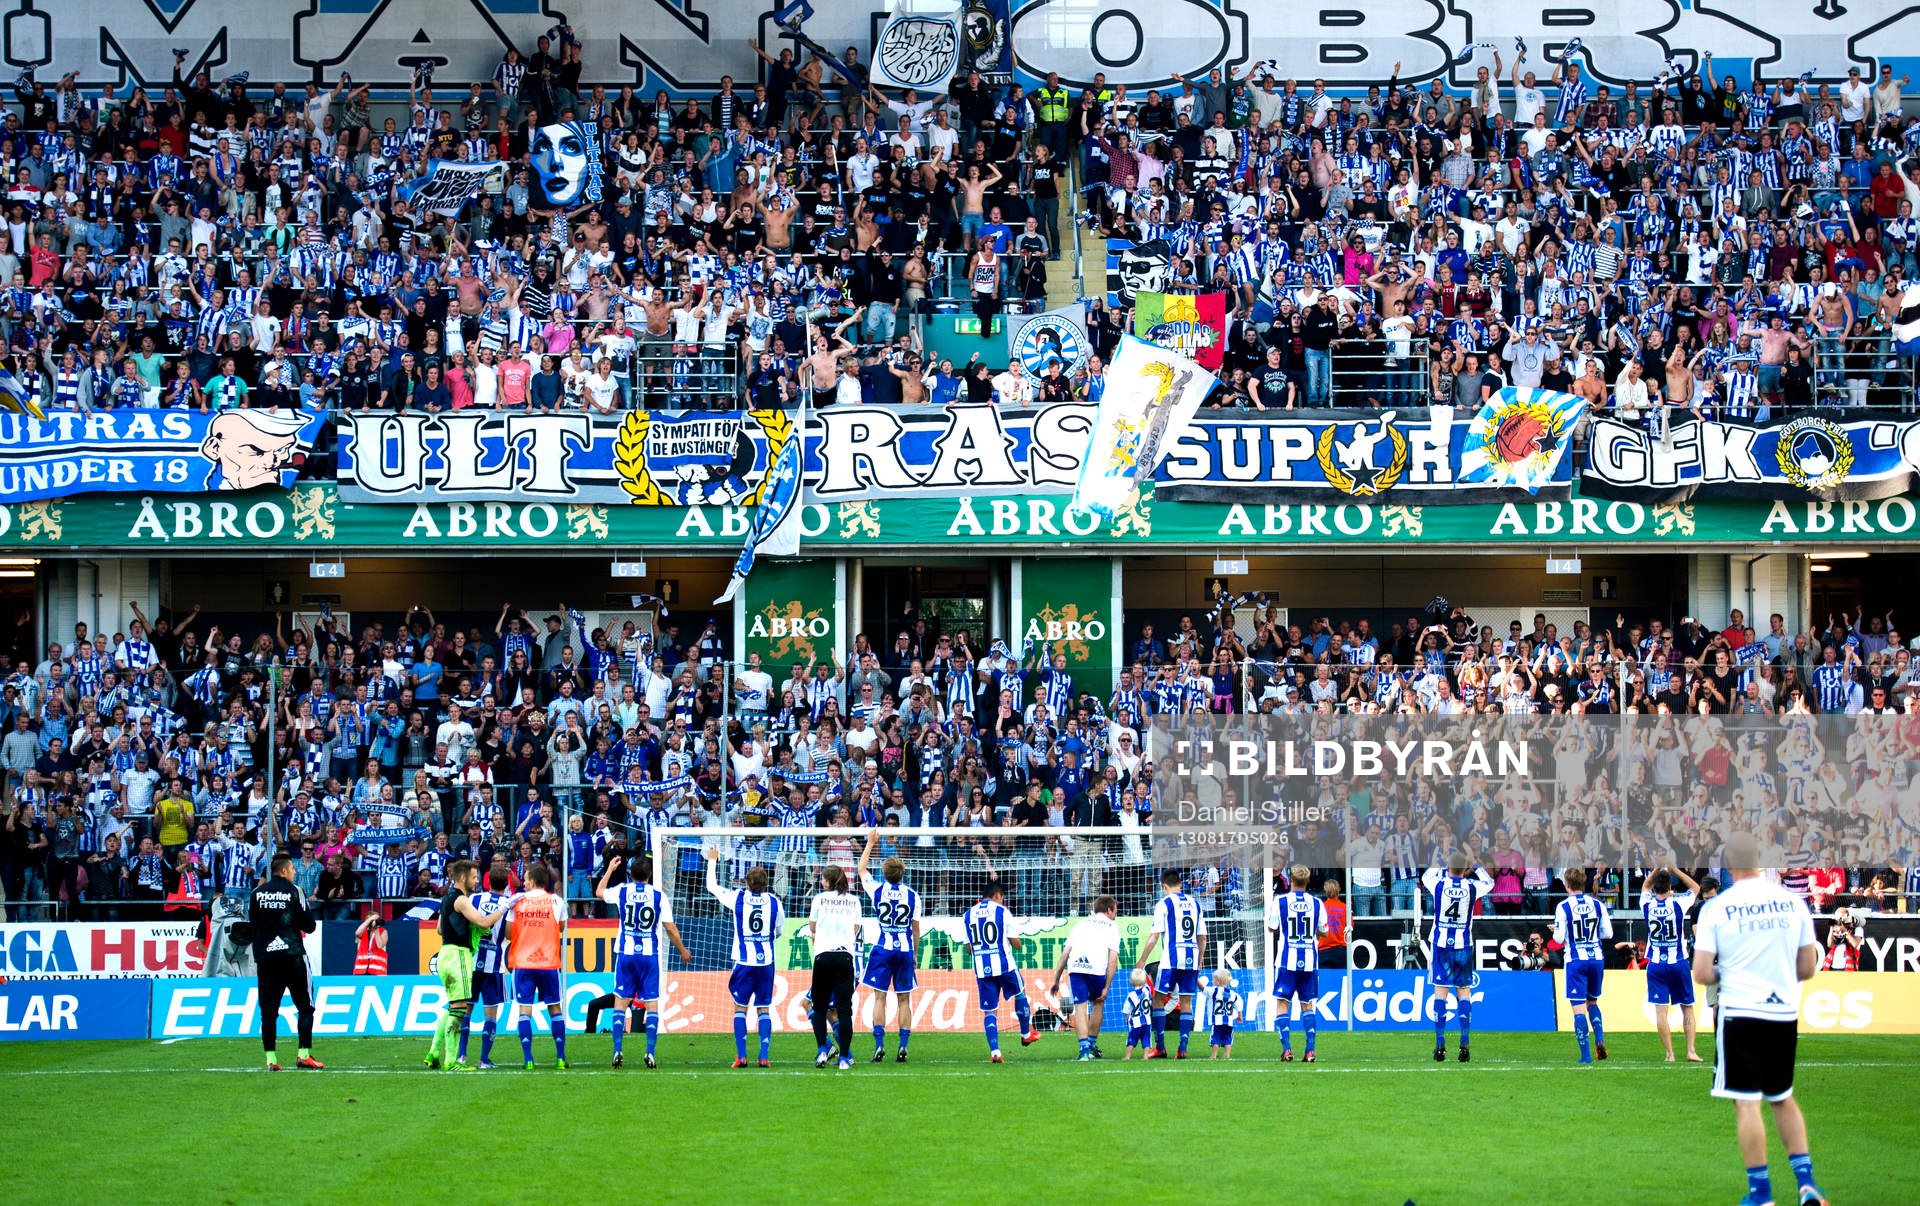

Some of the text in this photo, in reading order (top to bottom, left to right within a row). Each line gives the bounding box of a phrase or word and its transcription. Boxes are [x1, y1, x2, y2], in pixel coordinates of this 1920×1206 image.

[583, 121, 604, 201] ULTRAS
[977, 267, 995, 275] RUN
[0, 413, 193, 443] ULTRAS
[652, 422, 711, 440] SYMPATI
[1779, 416, 1849, 440] GÖTEBORGS FRIA
[345, 410, 592, 494] ULT
[653, 442, 668, 456] DE
[1166, 423, 1314, 481] SUP
[1590, 416, 1763, 488] GFK
[0, 458, 188, 494] UNDER 18
[128, 497, 285, 538] ÅBRO
[947, 496, 1101, 536] ÅBRO
[748, 615, 830, 638] ÅBRO
[1024, 617, 1106, 642] ÅBRO
[641, 777, 690, 792] GÖTEBORG
[355, 827, 415, 838] GAMLA ULLEVI
[382, 864, 401, 875] ICA
[256, 891, 292, 902] Prioritet
[259, 900, 287, 909] Finans
[624, 903, 656, 930] 19
[748, 909, 764, 934] 6
[879, 902, 910, 926] 22
[1444, 901, 1461, 922] 4
[1725, 899, 1797, 921] Prioritet
[970, 921, 998, 946] 10
[1181, 915, 1195, 940] 9
[1287, 917, 1313, 940] 11
[1572, 917, 1599, 942] 17
[1649, 920, 1678, 941] 21
[1738, 916, 1790, 934] Finans
[0, 930, 78, 972] GA
[266, 943, 290, 952] adidas
[1386, 938, 1524, 971] TYES
[746, 975, 969, 1031] Reova
[1214, 999, 1234, 1016] 29
